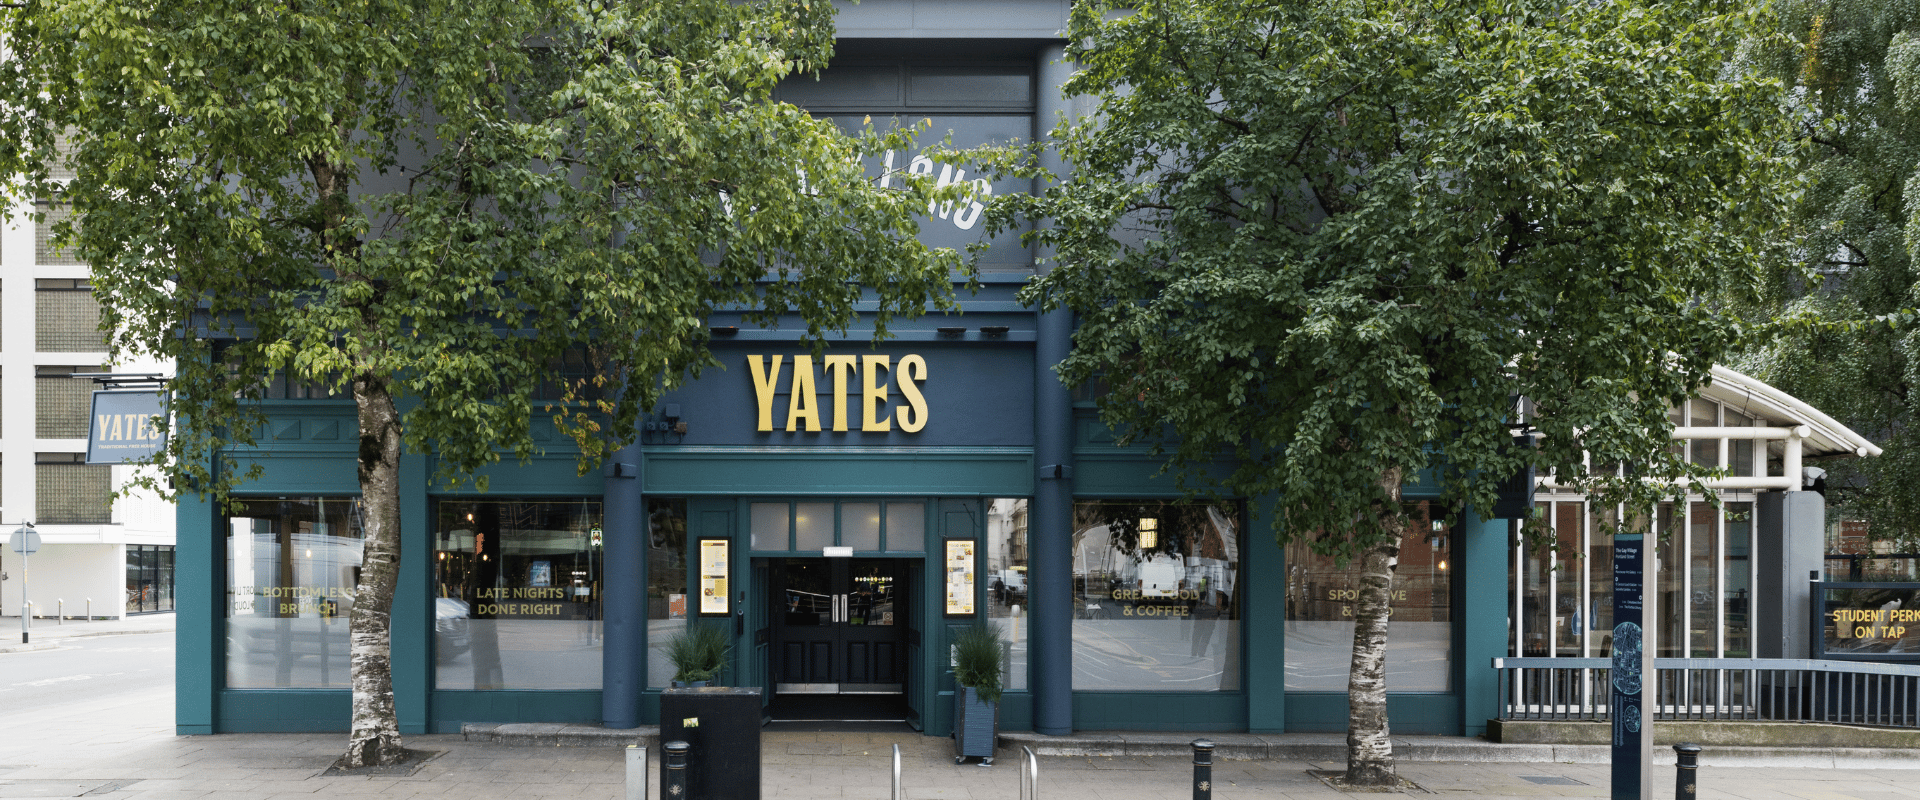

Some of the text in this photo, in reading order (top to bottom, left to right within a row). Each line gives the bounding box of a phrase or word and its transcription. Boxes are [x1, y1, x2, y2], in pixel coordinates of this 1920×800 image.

[747, 354, 929, 433] YATES
[98, 413, 160, 441] YATES
[262, 586, 354, 598] BOTTOMLESS
[476, 587, 564, 598] LATE NIGHTS
[1112, 589, 1200, 600] GRE OD
[1328, 589, 1360, 600] SPO
[280, 603, 336, 614] BRUNCH
[478, 604, 562, 615] DONE RIGHT
[1122, 605, 1189, 616] & COFFEE
[1341, 606, 1353, 617] &
[1833, 609, 1886, 622] STUDENT
[1855, 626, 1906, 639] ON TAP
